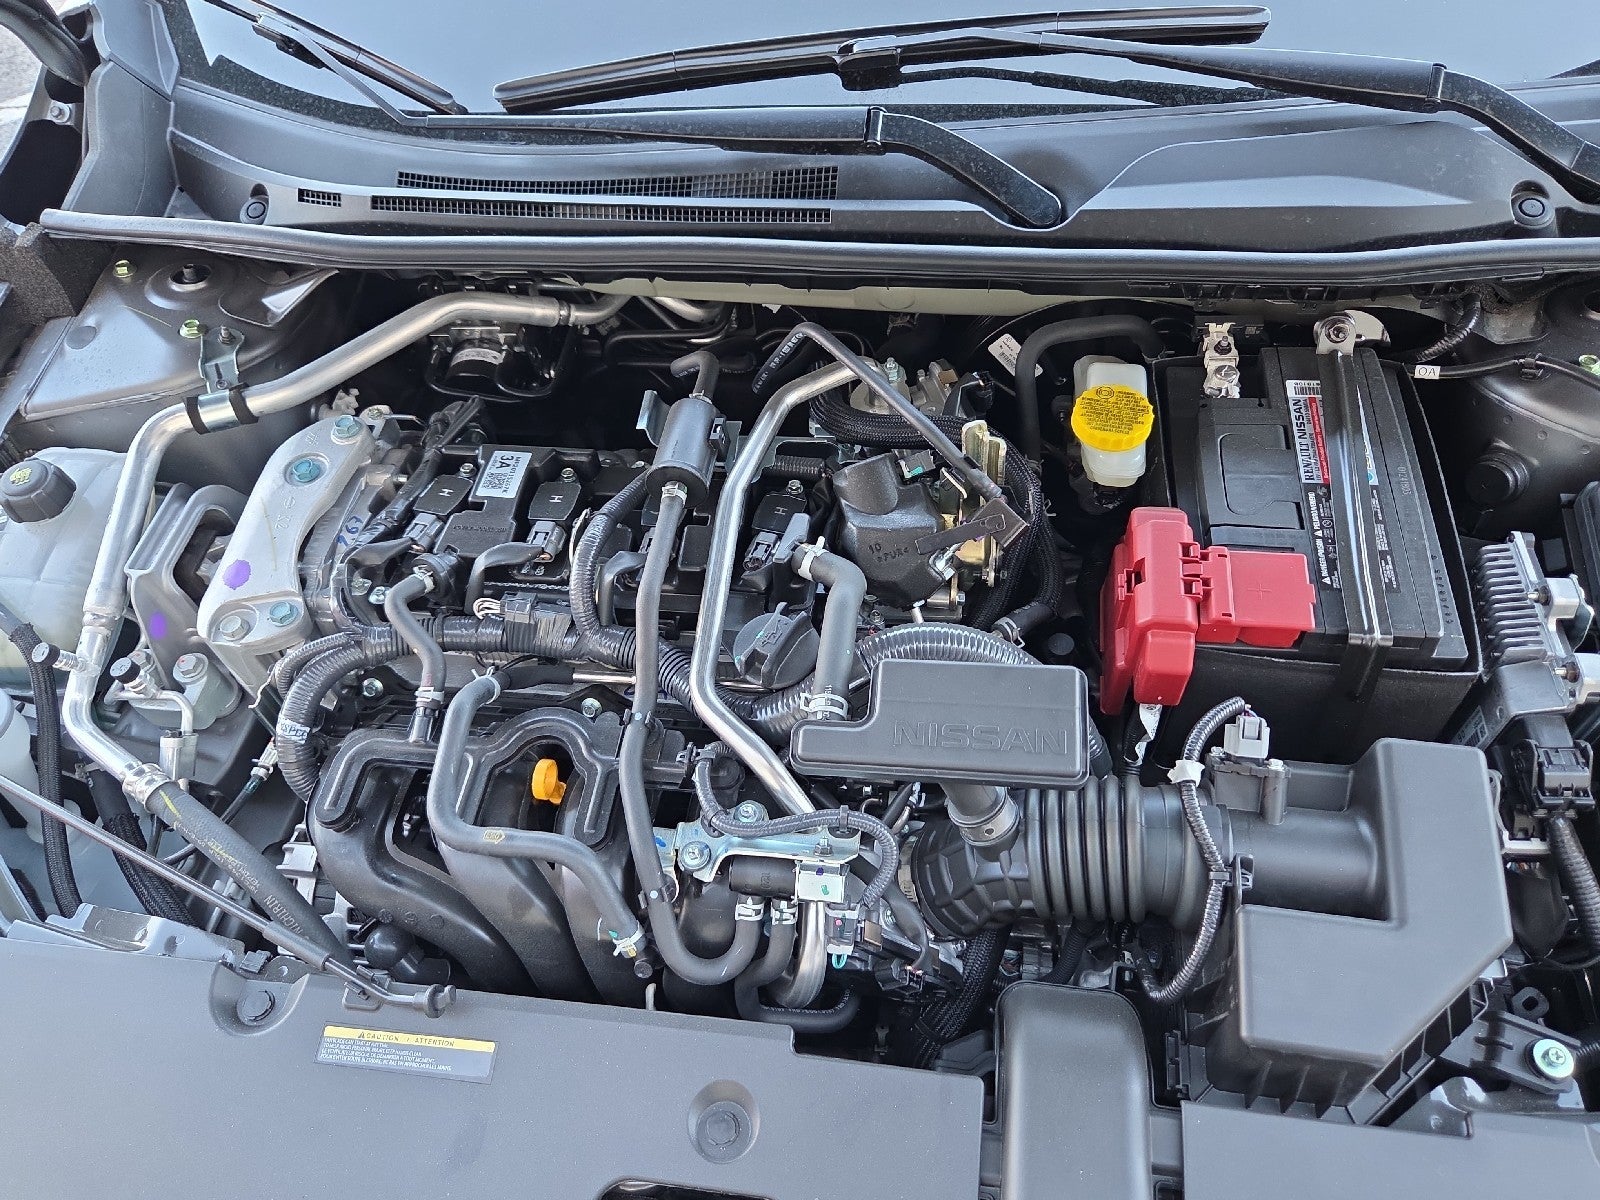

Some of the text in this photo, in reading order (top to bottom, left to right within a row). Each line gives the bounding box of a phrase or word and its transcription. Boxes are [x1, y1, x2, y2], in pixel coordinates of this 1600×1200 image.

[1292, 399, 1308, 439] NISSAN
[1299, 441, 1315, 481] RENAULT
[893, 719, 1068, 755] NISSAN
[363, 1031, 399, 1042] CAUTION
[414, 1037, 455, 1048] ATTENTION
